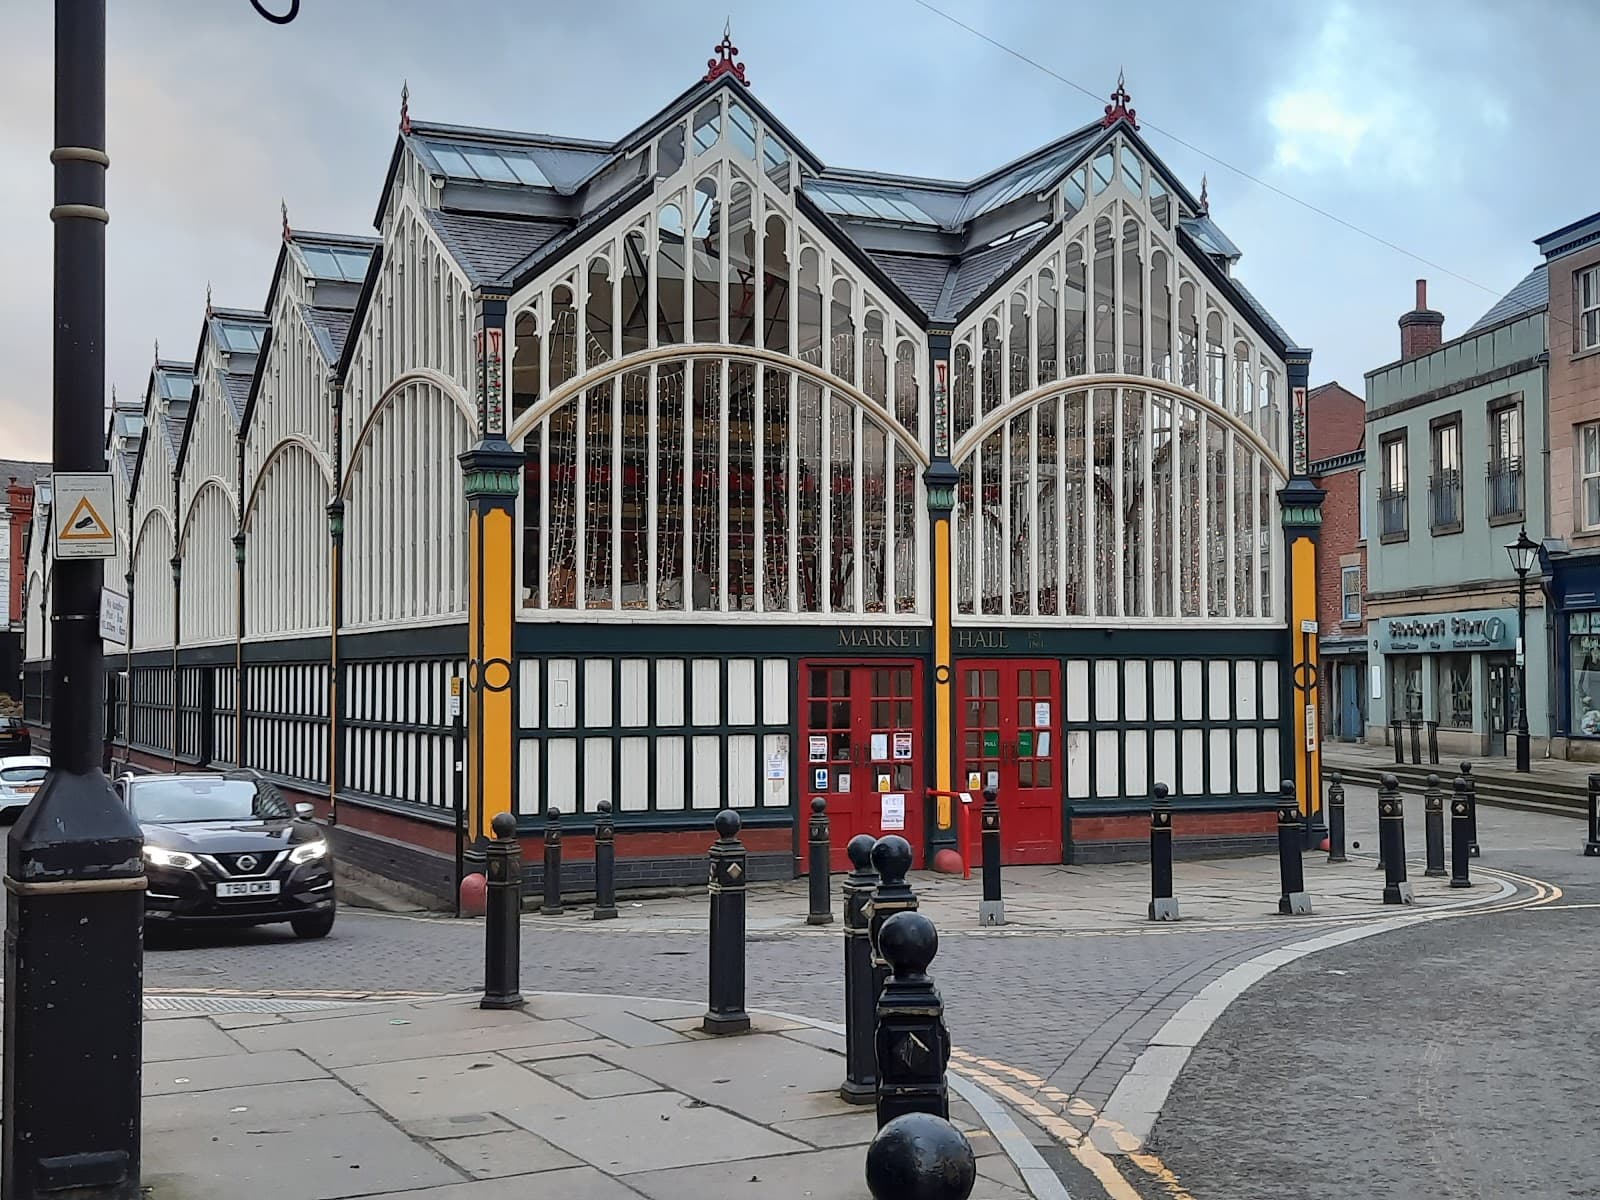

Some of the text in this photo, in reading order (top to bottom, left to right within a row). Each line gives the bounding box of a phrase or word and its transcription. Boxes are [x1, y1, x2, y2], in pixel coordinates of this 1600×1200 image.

[838, 629, 1009, 648] MARKET HALL
[1373, 640, 1379, 650] 9
